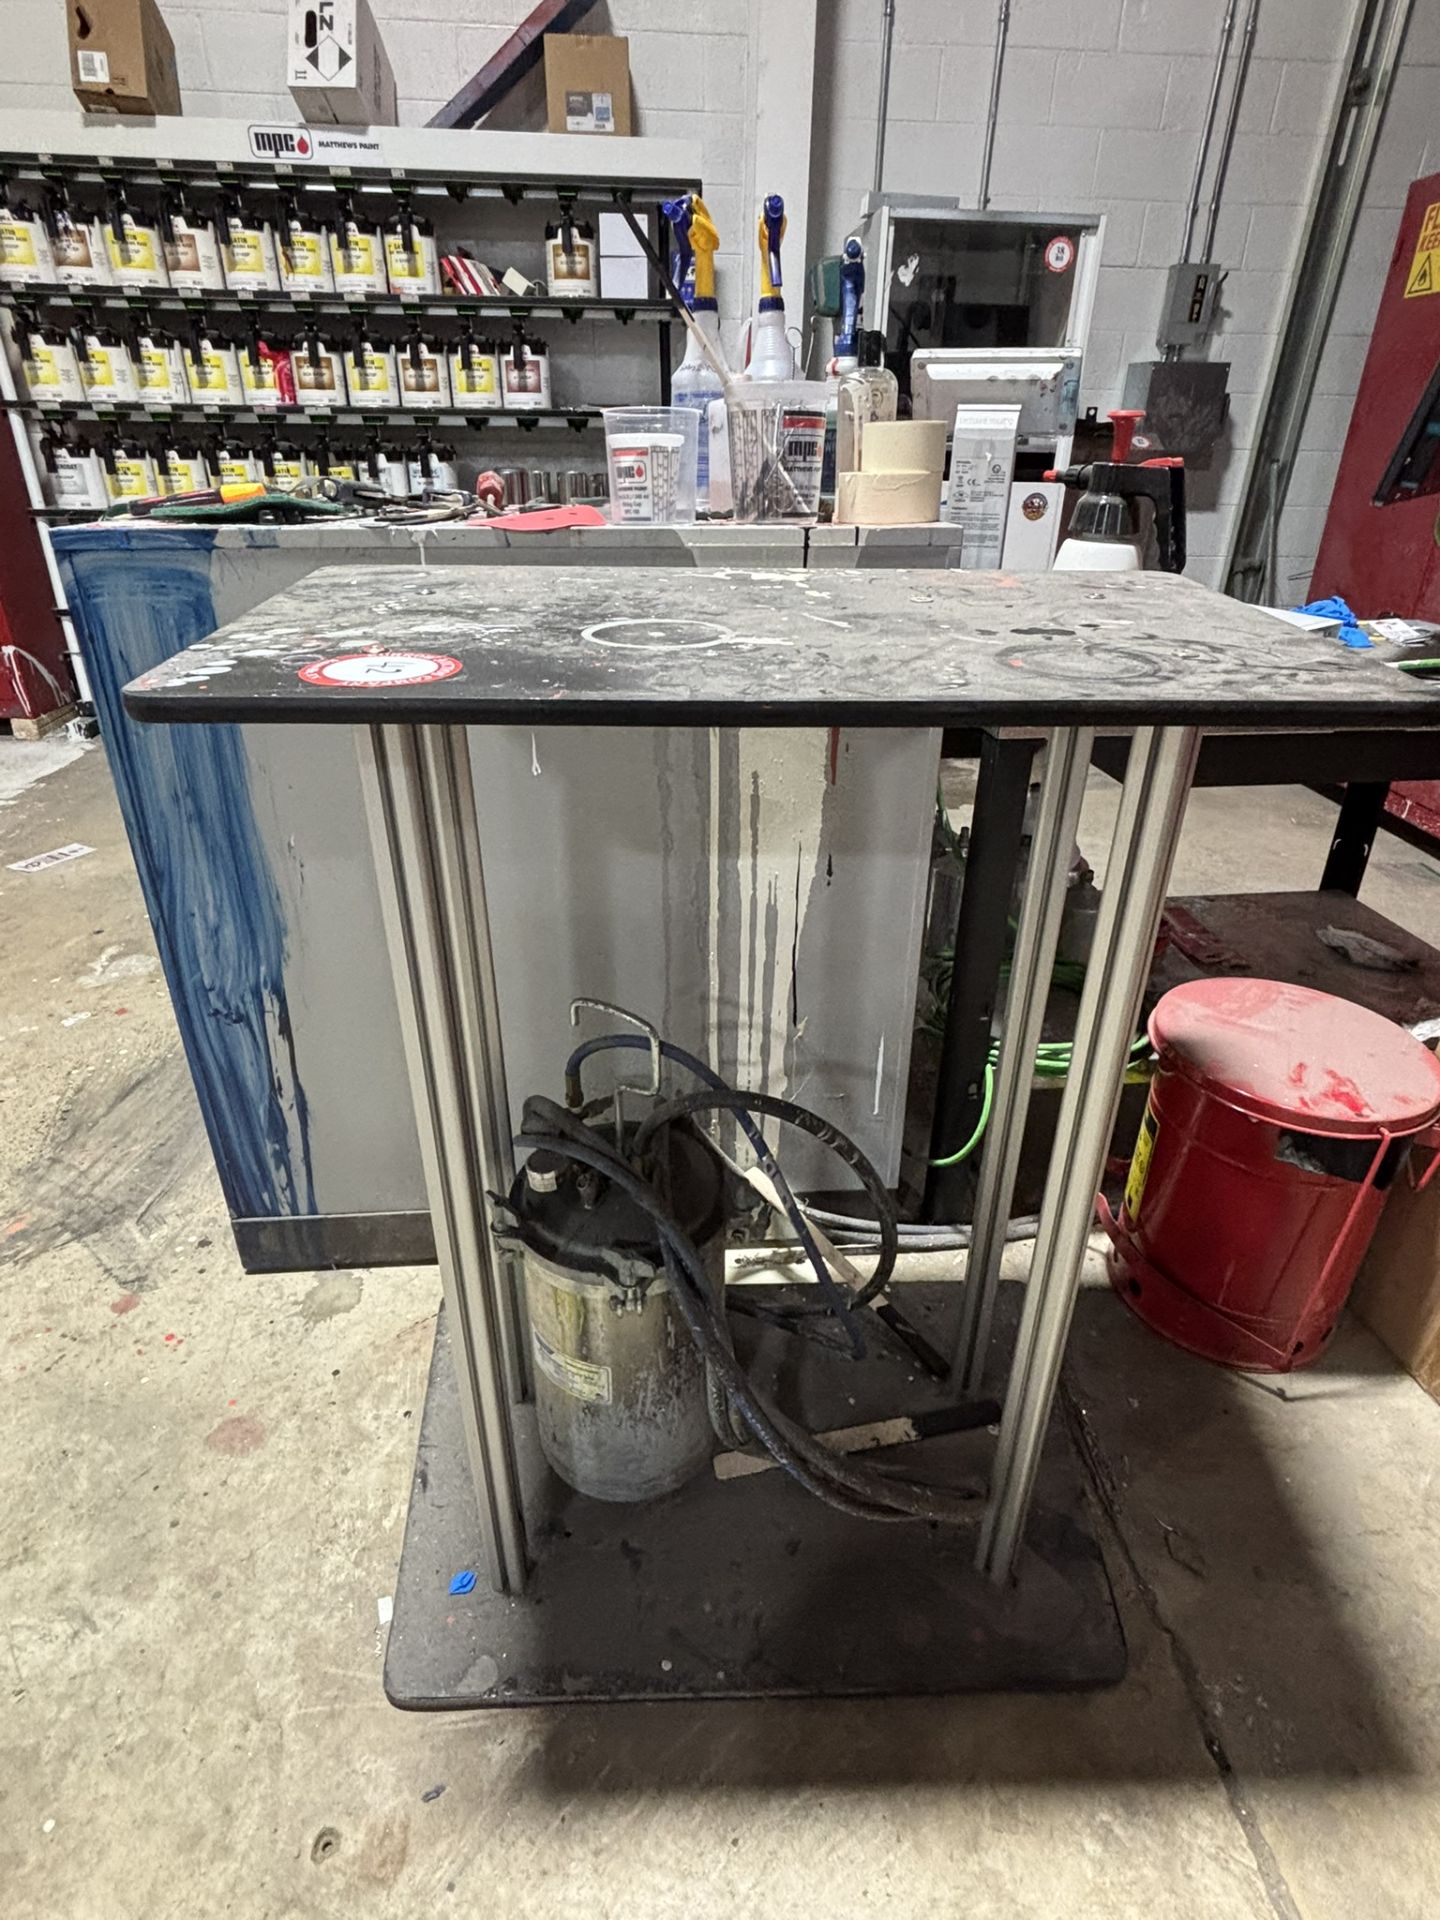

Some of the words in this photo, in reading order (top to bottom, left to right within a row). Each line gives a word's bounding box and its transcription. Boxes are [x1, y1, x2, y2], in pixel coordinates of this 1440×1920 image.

[254, 133, 295, 158] mpc
[318, 140, 358, 149] MATTHEWS
[359, 142, 380, 150] PAINT
[787, 440, 818, 462] mpc
